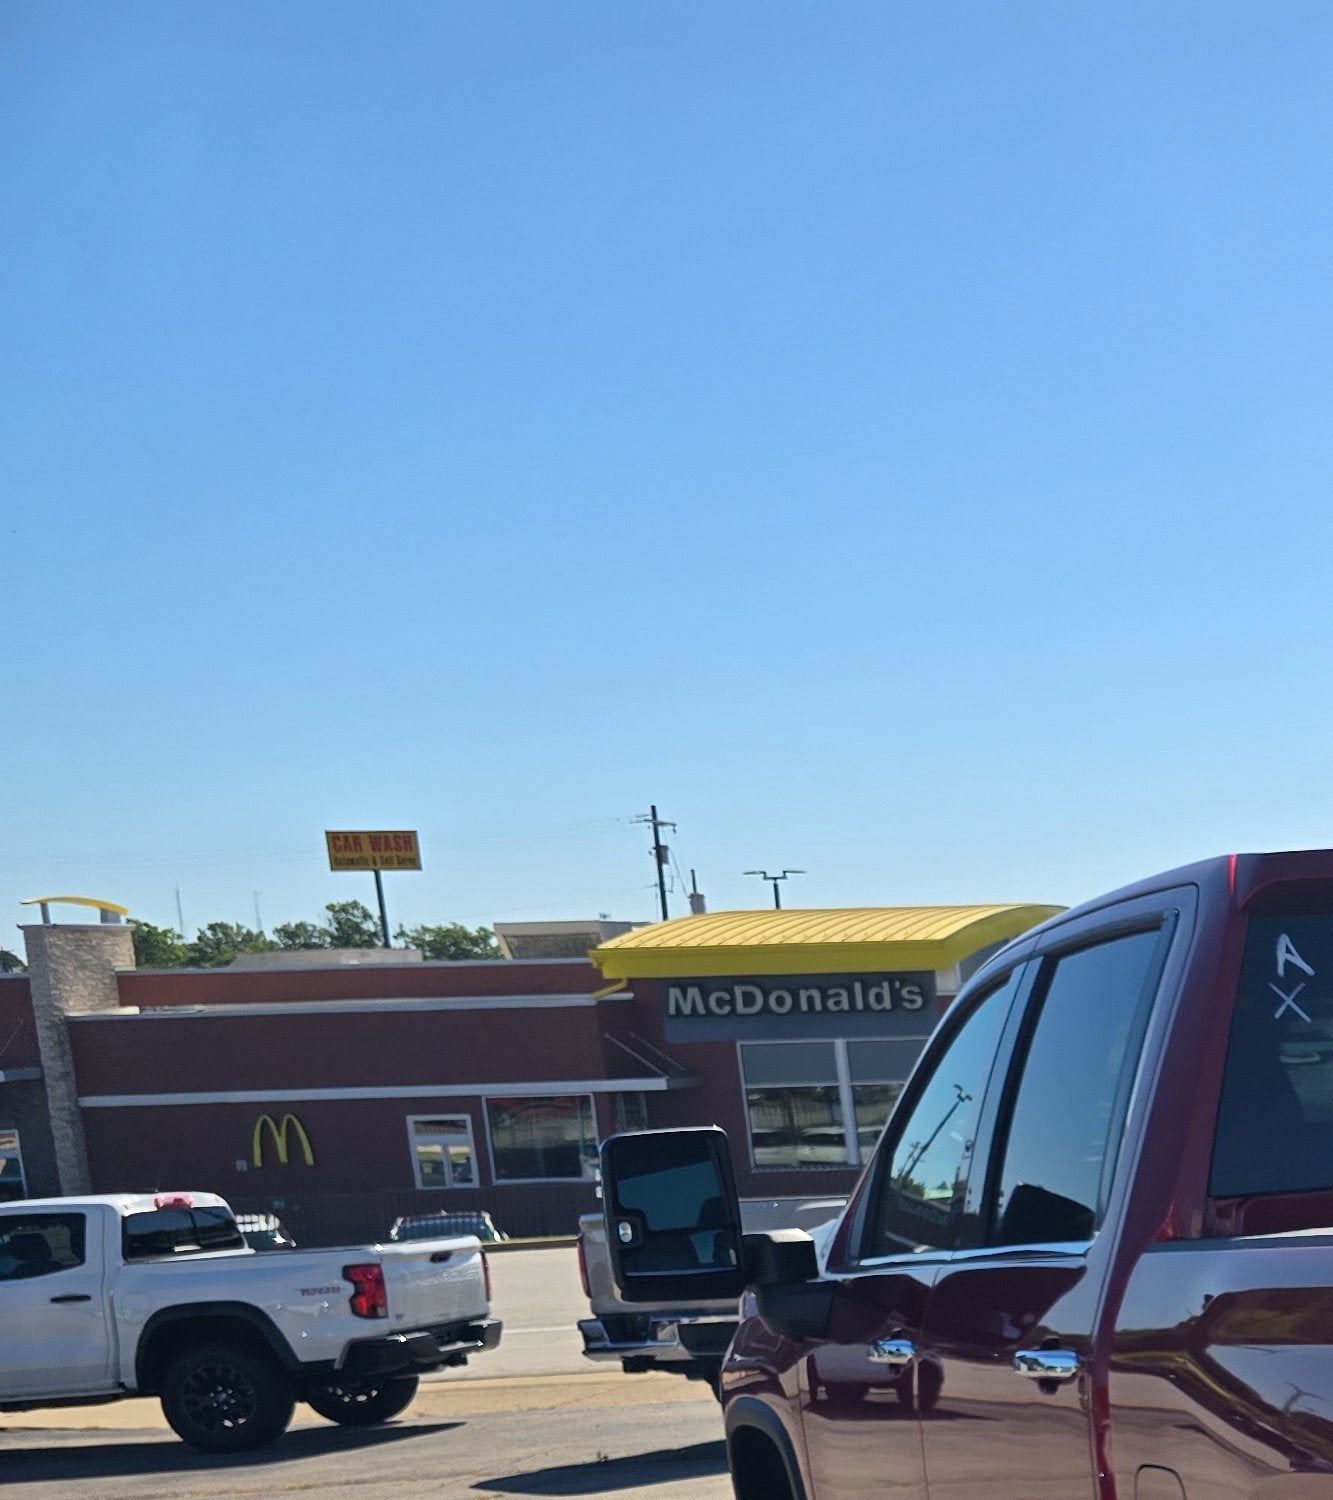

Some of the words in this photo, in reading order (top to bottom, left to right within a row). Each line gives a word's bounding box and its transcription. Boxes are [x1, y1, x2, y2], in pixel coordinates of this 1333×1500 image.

[332, 834, 363, 853] CAR
[368, 833, 413, 853] WASH
[668, 980, 924, 1016] McDonald's
